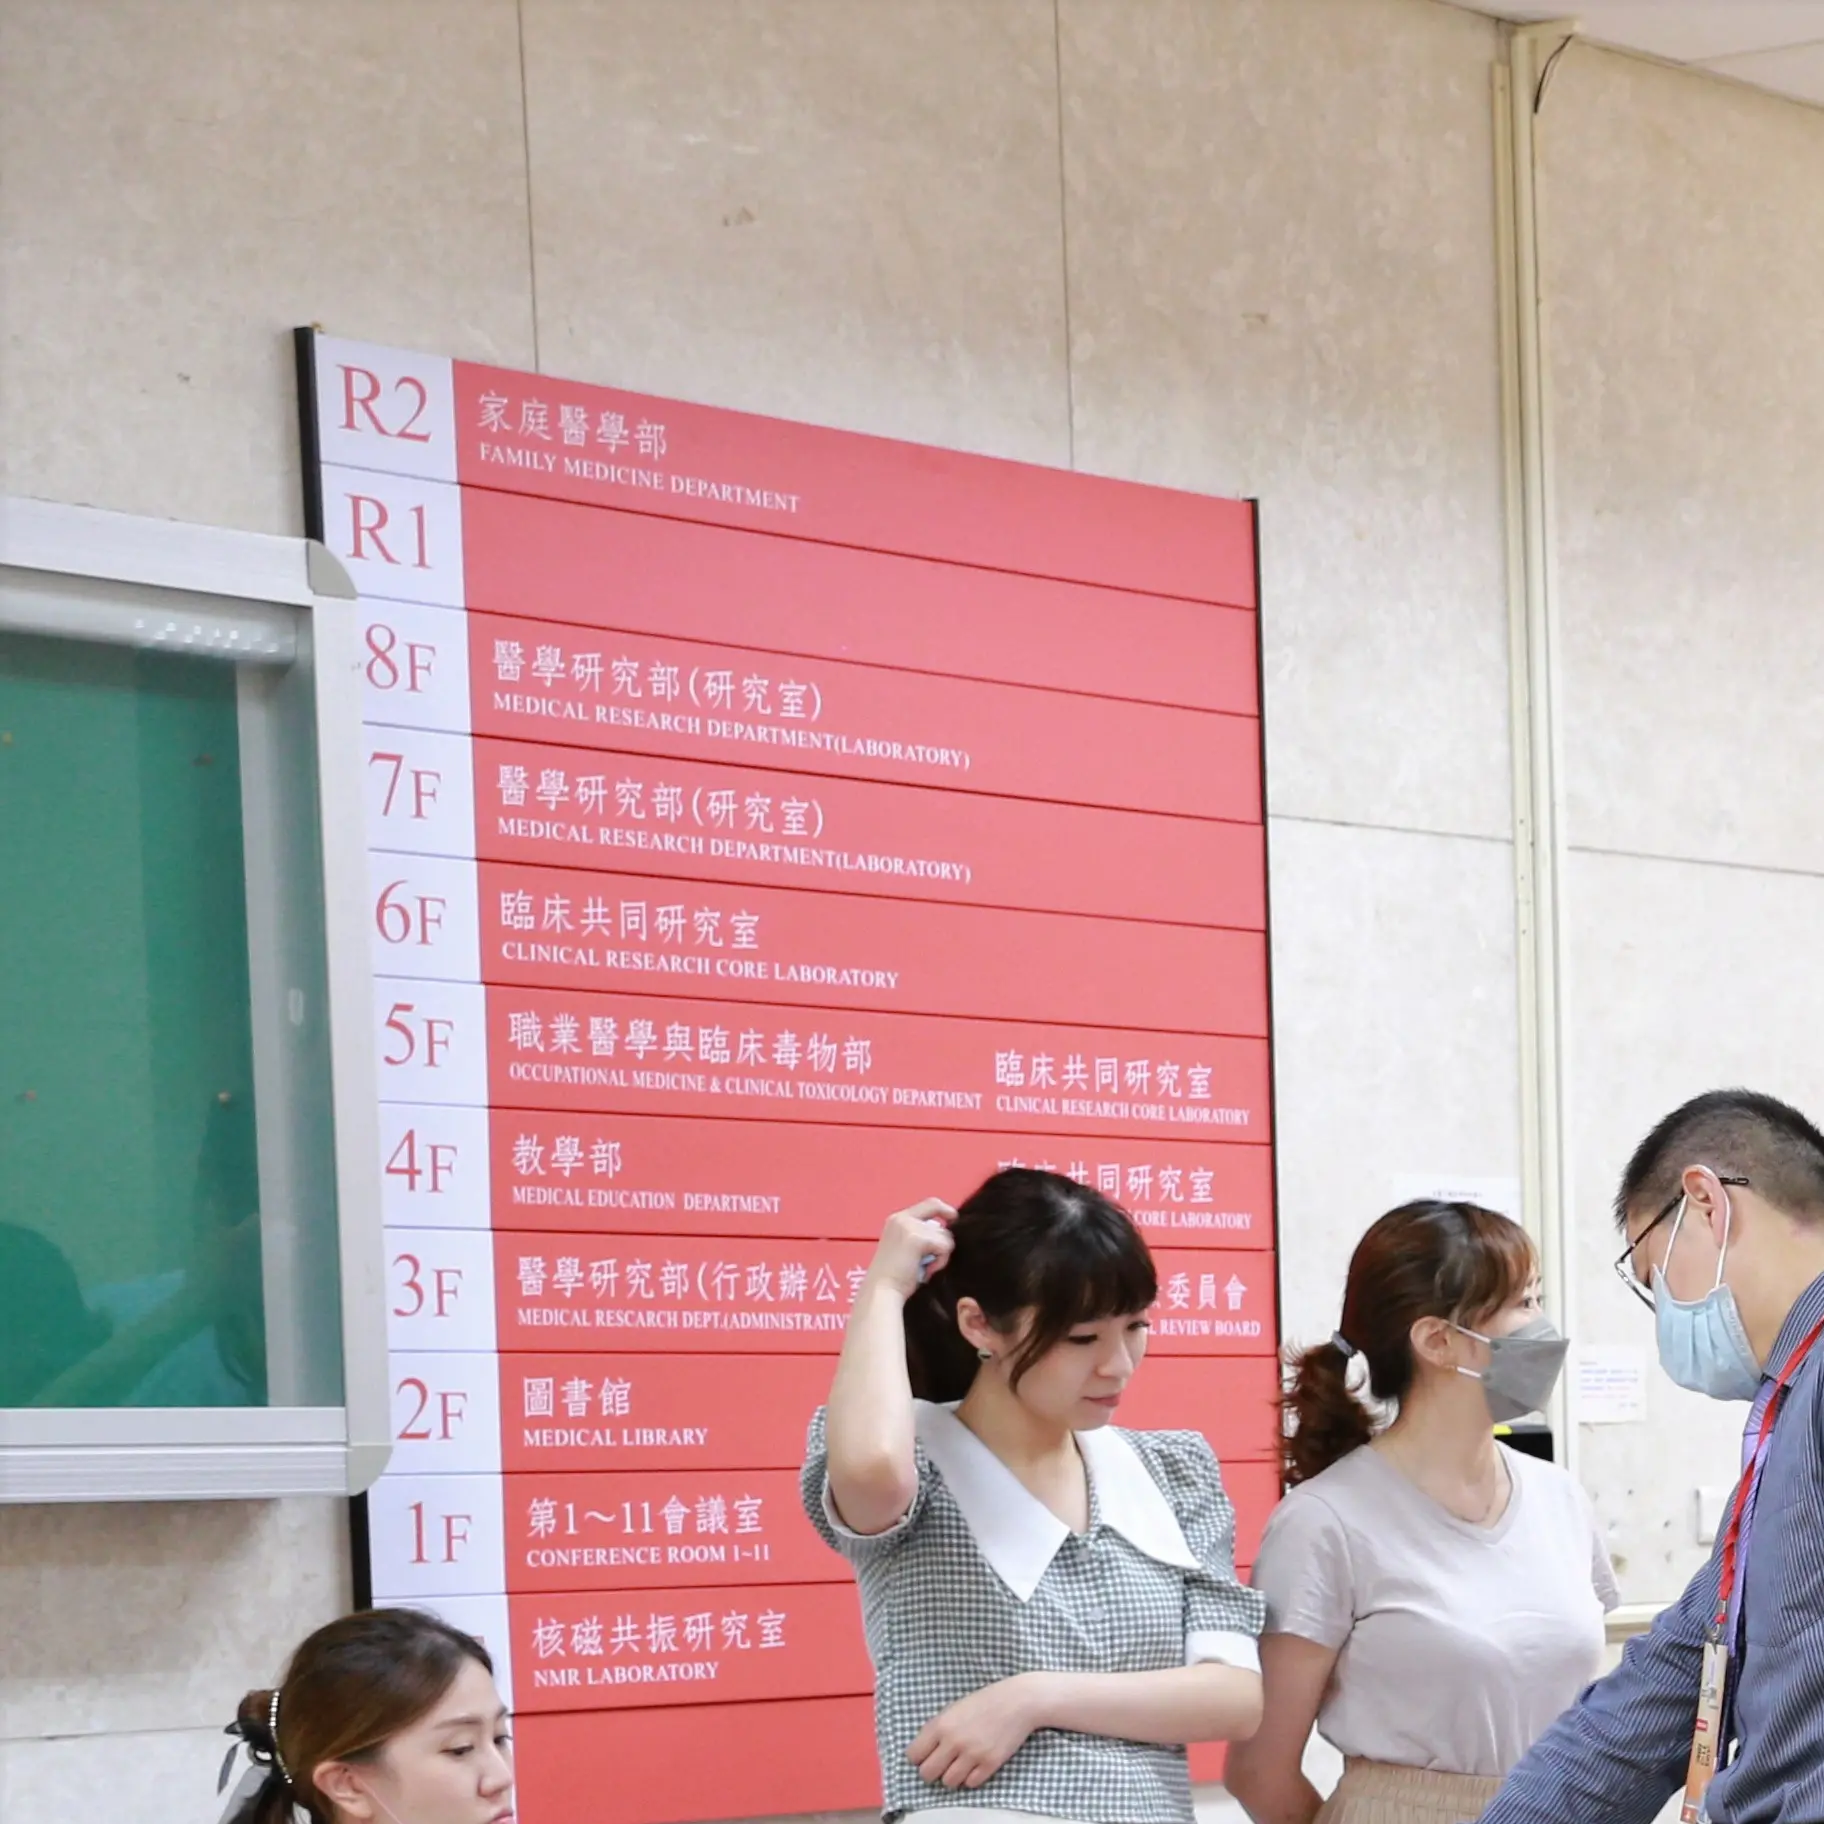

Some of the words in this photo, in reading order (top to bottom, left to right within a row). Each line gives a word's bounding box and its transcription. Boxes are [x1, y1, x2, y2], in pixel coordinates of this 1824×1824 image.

[336, 364, 431, 443] R2
[477, 392, 669, 461] 家庭醫學部
[480, 442, 556, 473] FAMILY
[563, 455, 665, 491] MEDICINE
[670, 477, 801, 514] DEPARTMENT
[344, 493, 433, 570] R1
[364, 622, 436, 693] 8F
[492, 638, 824, 721] 醫學研究部(研究室)
[493, 691, 590, 722] MEDICAL
[596, 704, 701, 735] RESEARCH
[708, 718, 971, 771] DEPARTMENT(LABORATORY)
[368, 752, 442, 820] 7F
[497, 764, 825, 840] 醫學研究部(研究室)
[498, 816, 594, 845] MEDICAL
[600, 828, 704, 856] RESEARCH
[711, 839, 972, 885] DEPARTMENT(LABORATORY)
[375, 879, 448, 946] 6F
[500, 888, 761, 951] 臨床共同研究室
[502, 941, 600, 967] CLINICAL
[606, 949, 710, 976] RESEARCH
[717, 958, 768, 980] CORE
[774, 962, 899, 990] LABORATORY
[383, 1002, 455, 1068] 5F
[508, 1011, 873, 1075] 職業醫學與臨床毒物部
[509, 1062, 627, 1087] OCCUPATIONAL
[632, 1069, 706, 1093] MEDICINE
[710, 1077, 721, 1093] &
[725, 1077, 794, 1099] CLINICAL
[798, 1081, 888, 1105] TOXICOLOGY
[892, 1087, 983, 1110] DEPARTMENT
[995, 1048, 1212, 1099] 臨床共同研究室
[995, 1095, 1060, 1115] CLINICAL
[1061, 1098, 1129, 1120] RESEARCH
[1132, 1103, 1166, 1121] CORE
[1169, 1105, 1250, 1126] LABORATORY
[384, 1127, 458, 1193] 4F
[511, 1132, 623, 1179] 教學部
[998, 1158, 1214, 1203] 共同研究室
[512, 1185, 584, 1208] MEDICAL
[588, 1188, 676, 1211] EDUCATION
[683, 1190, 780, 1214] DEPARTMENT
[1135, 1211, 1168, 1226] CORE
[1171, 1211, 1252, 1230] LABORATORY
[392, 1253, 463, 1317] 3F
[1152, 1271, 1248, 1311] 委員會
[518, 1308, 591, 1328] MEDICAL
[1160, 1319, 1211, 1336] REVIEW
[1215, 1320, 1261, 1337] BOARD
[396, 1377, 467, 1440] 2F
[523, 1375, 632, 1418] 圖書館
[523, 1427, 618, 1447] MEDICAL
[622, 1427, 709, 1447] LIBRARY
[407, 1501, 472, 1565] 1F
[526, 1545, 662, 1568] CONFERENCE
[667, 1543, 726, 1563] ROOM
[531, 1608, 787, 1660] 核磁共振研究室
[533, 1667, 581, 1688] NMR
[586, 1661, 720, 1686] LABORATORY
